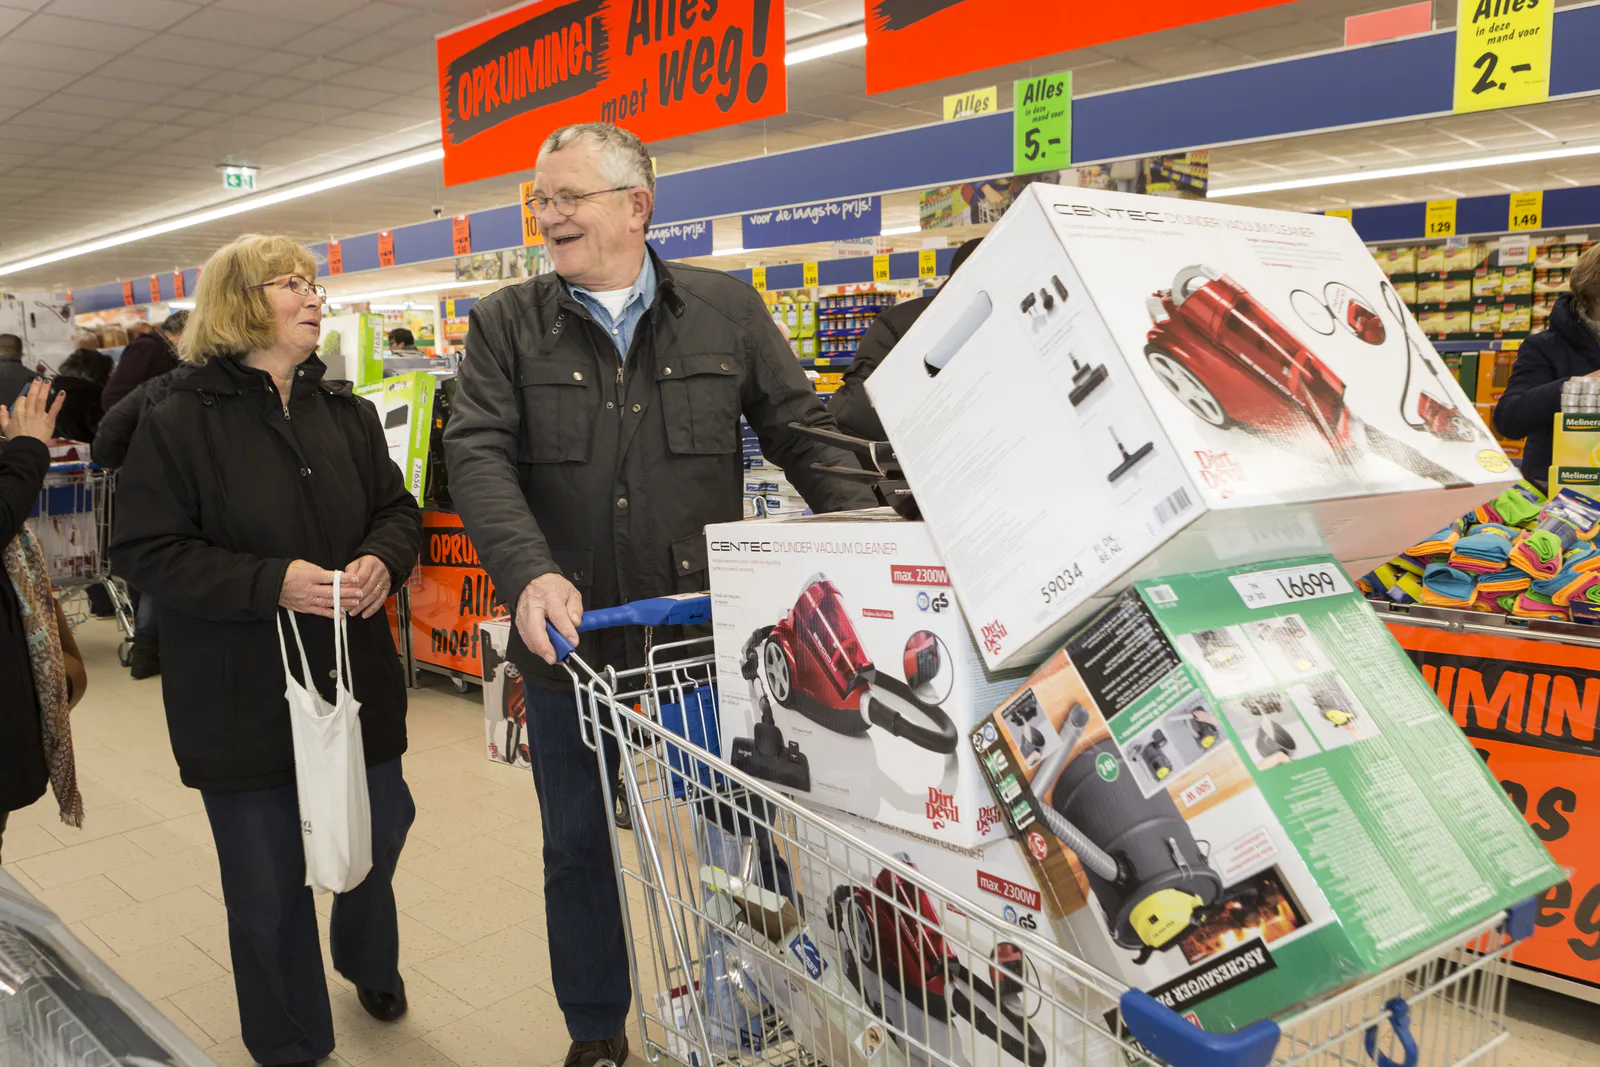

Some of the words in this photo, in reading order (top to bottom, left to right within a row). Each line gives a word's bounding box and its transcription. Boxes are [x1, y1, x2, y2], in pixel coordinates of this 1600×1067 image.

[1475, 27, 1485, 36] in
[1489, 22, 1510, 33] deze
[1487, 29, 1515, 45] mand
[1518, 27, 1540, 38] voor
[458, 15, 594, 121] OPRUIMING!
[601, 78, 648, 124] moet
[659, 0, 770, 112] weg!
[1471, 52, 1531, 95] 2.-
[1023, 78, 1064, 106] Alles
[953, 94, 989, 119] Alles
[1032, 112, 1049, 123] mand
[1051, 110, 1064, 119] voor
[1033, 106, 1046, 114] deze
[1024, 127, 1061, 161] 5.-
[750, 212, 773, 225] voor
[775, 209, 792, 222] de
[793, 202, 840, 224] laagste
[841, 196, 872, 219] prijs!
[1053, 203, 1165, 223] CENTEC
[1164, 212, 1221, 228] CYLINDER
[1223, 217, 1270, 234] VACUUM
[1270, 222, 1316, 238] CLEANER
[1514, 214, 1538, 226] 1.49
[646, 223, 682, 244] aagste
[682, 220, 706, 241] prijs!
[1430, 221, 1451, 233] 1.29
[413, 463, 422, 489] 71656
[1561, 472, 1598, 480] Melinera
[430, 533, 481, 566] OPRU
[710, 541, 772, 553] CENTEC
[773, 541, 812, 553] CYLINDER
[814, 541, 854, 554] VACUUM
[855, 541, 898, 555] CLEANER
[893, 569, 915, 582] max.
[916, 568, 948, 584] 2300W
[1041, 562, 1083, 604] 59034
[1276, 571, 1336, 599] 66991
[459, 574, 510, 618] Alle
[932, 592, 949, 613] GS
[981, 619, 1001, 639] Dirt
[984, 624, 1008, 653] Devil
[431, 624, 479, 659] moet
[928, 786, 954, 808] Dirt
[925, 801, 960, 823] Devil
[976, 811, 1001, 832] Devil
[978, 805, 998, 819] Dirt
[980, 876, 1001, 894] max.
[1003, 882, 1036, 907] 2300W
[1018, 913, 1037, 930] GS
